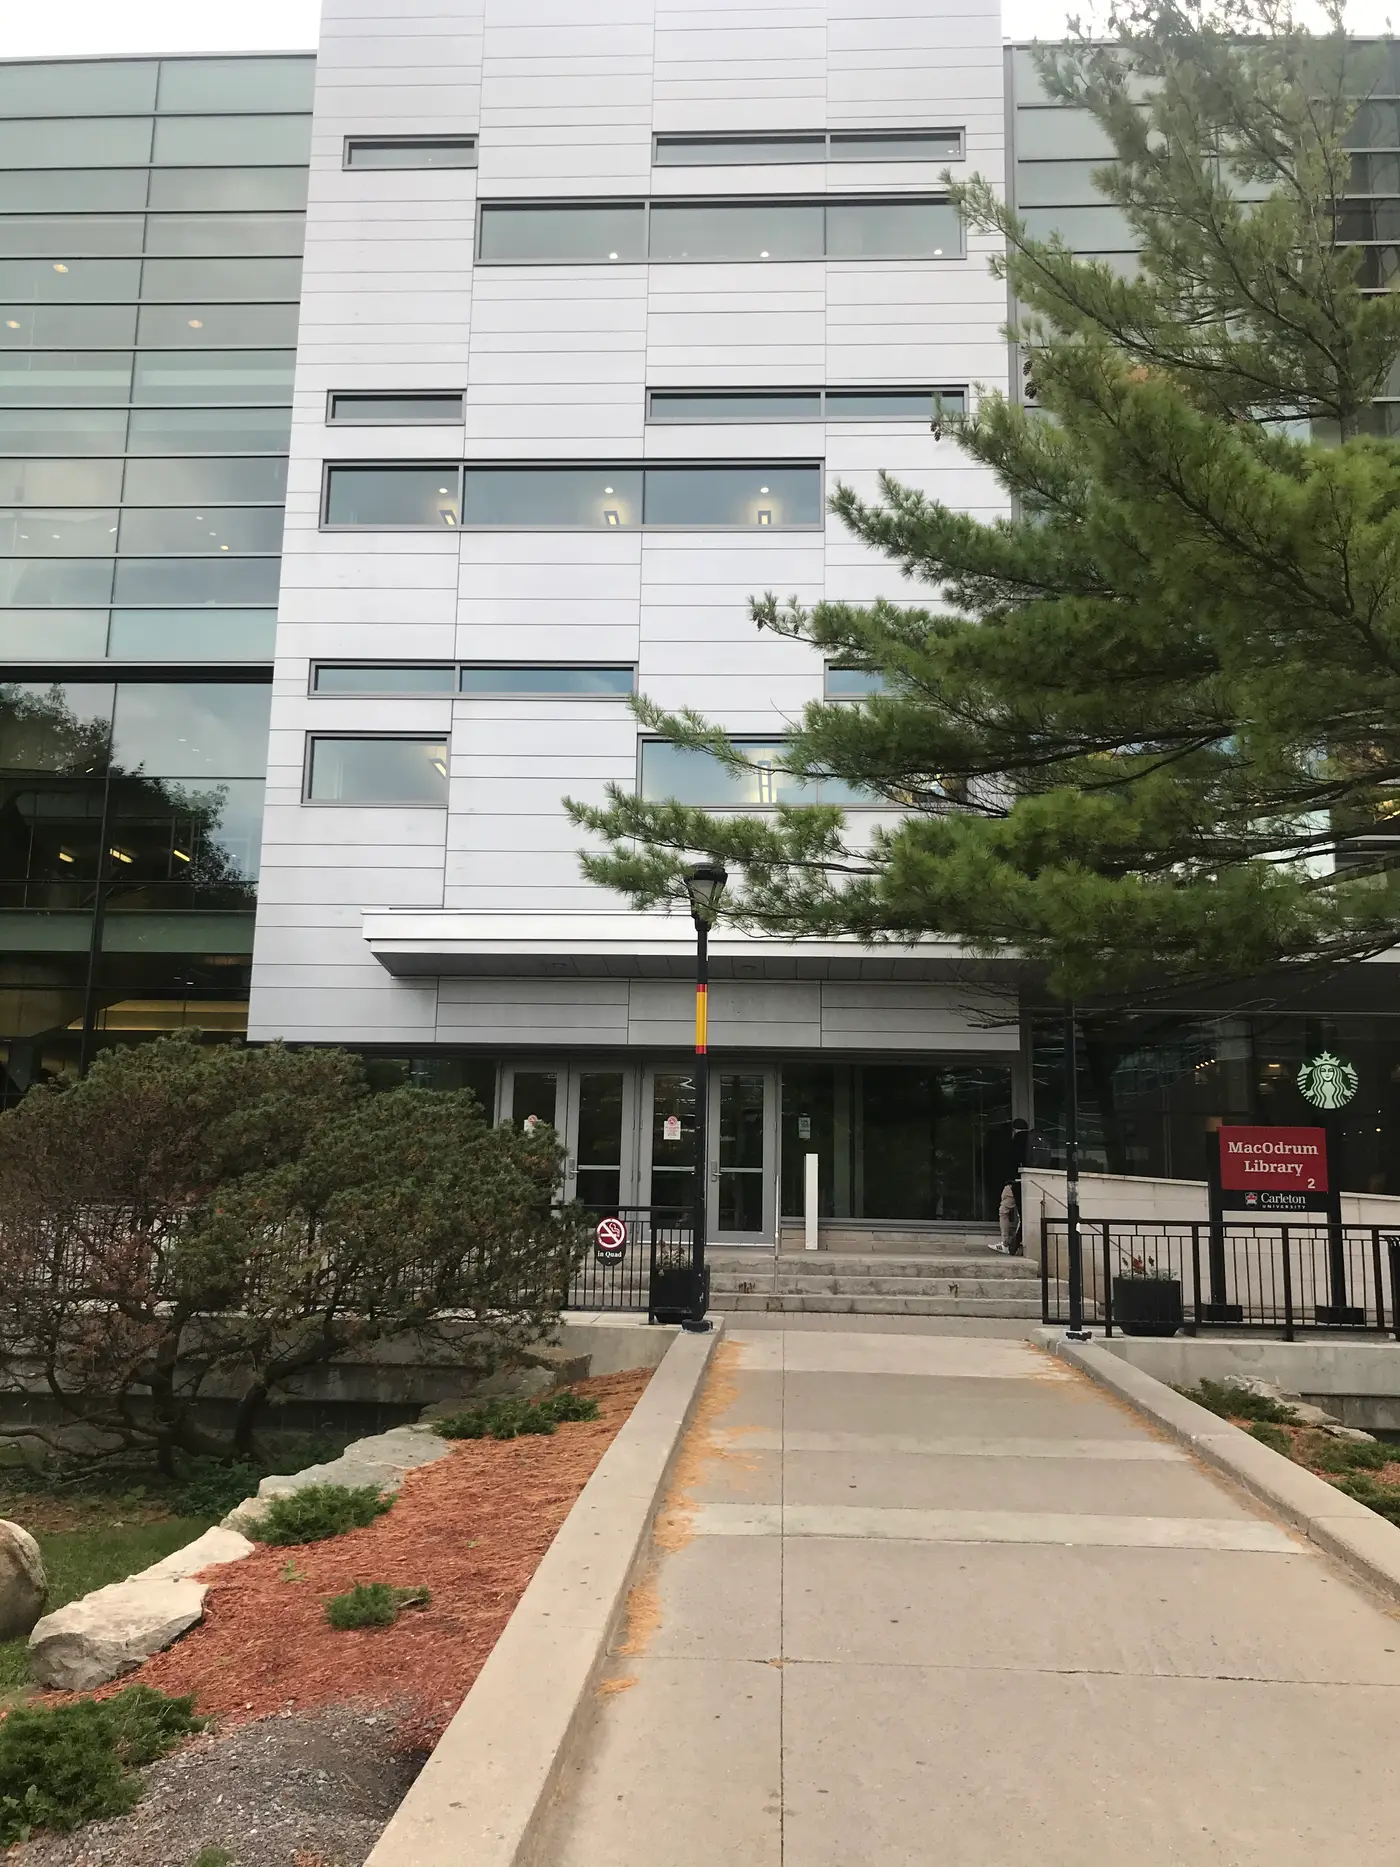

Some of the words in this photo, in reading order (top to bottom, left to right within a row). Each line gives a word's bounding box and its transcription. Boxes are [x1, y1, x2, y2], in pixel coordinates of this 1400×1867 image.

[1228, 1141, 1318, 1155] MacOdrum
[1244, 1160, 1303, 1177] Library
[1307, 1178, 1316, 1189] 2
[1261, 1192, 1306, 1204] Carleton
